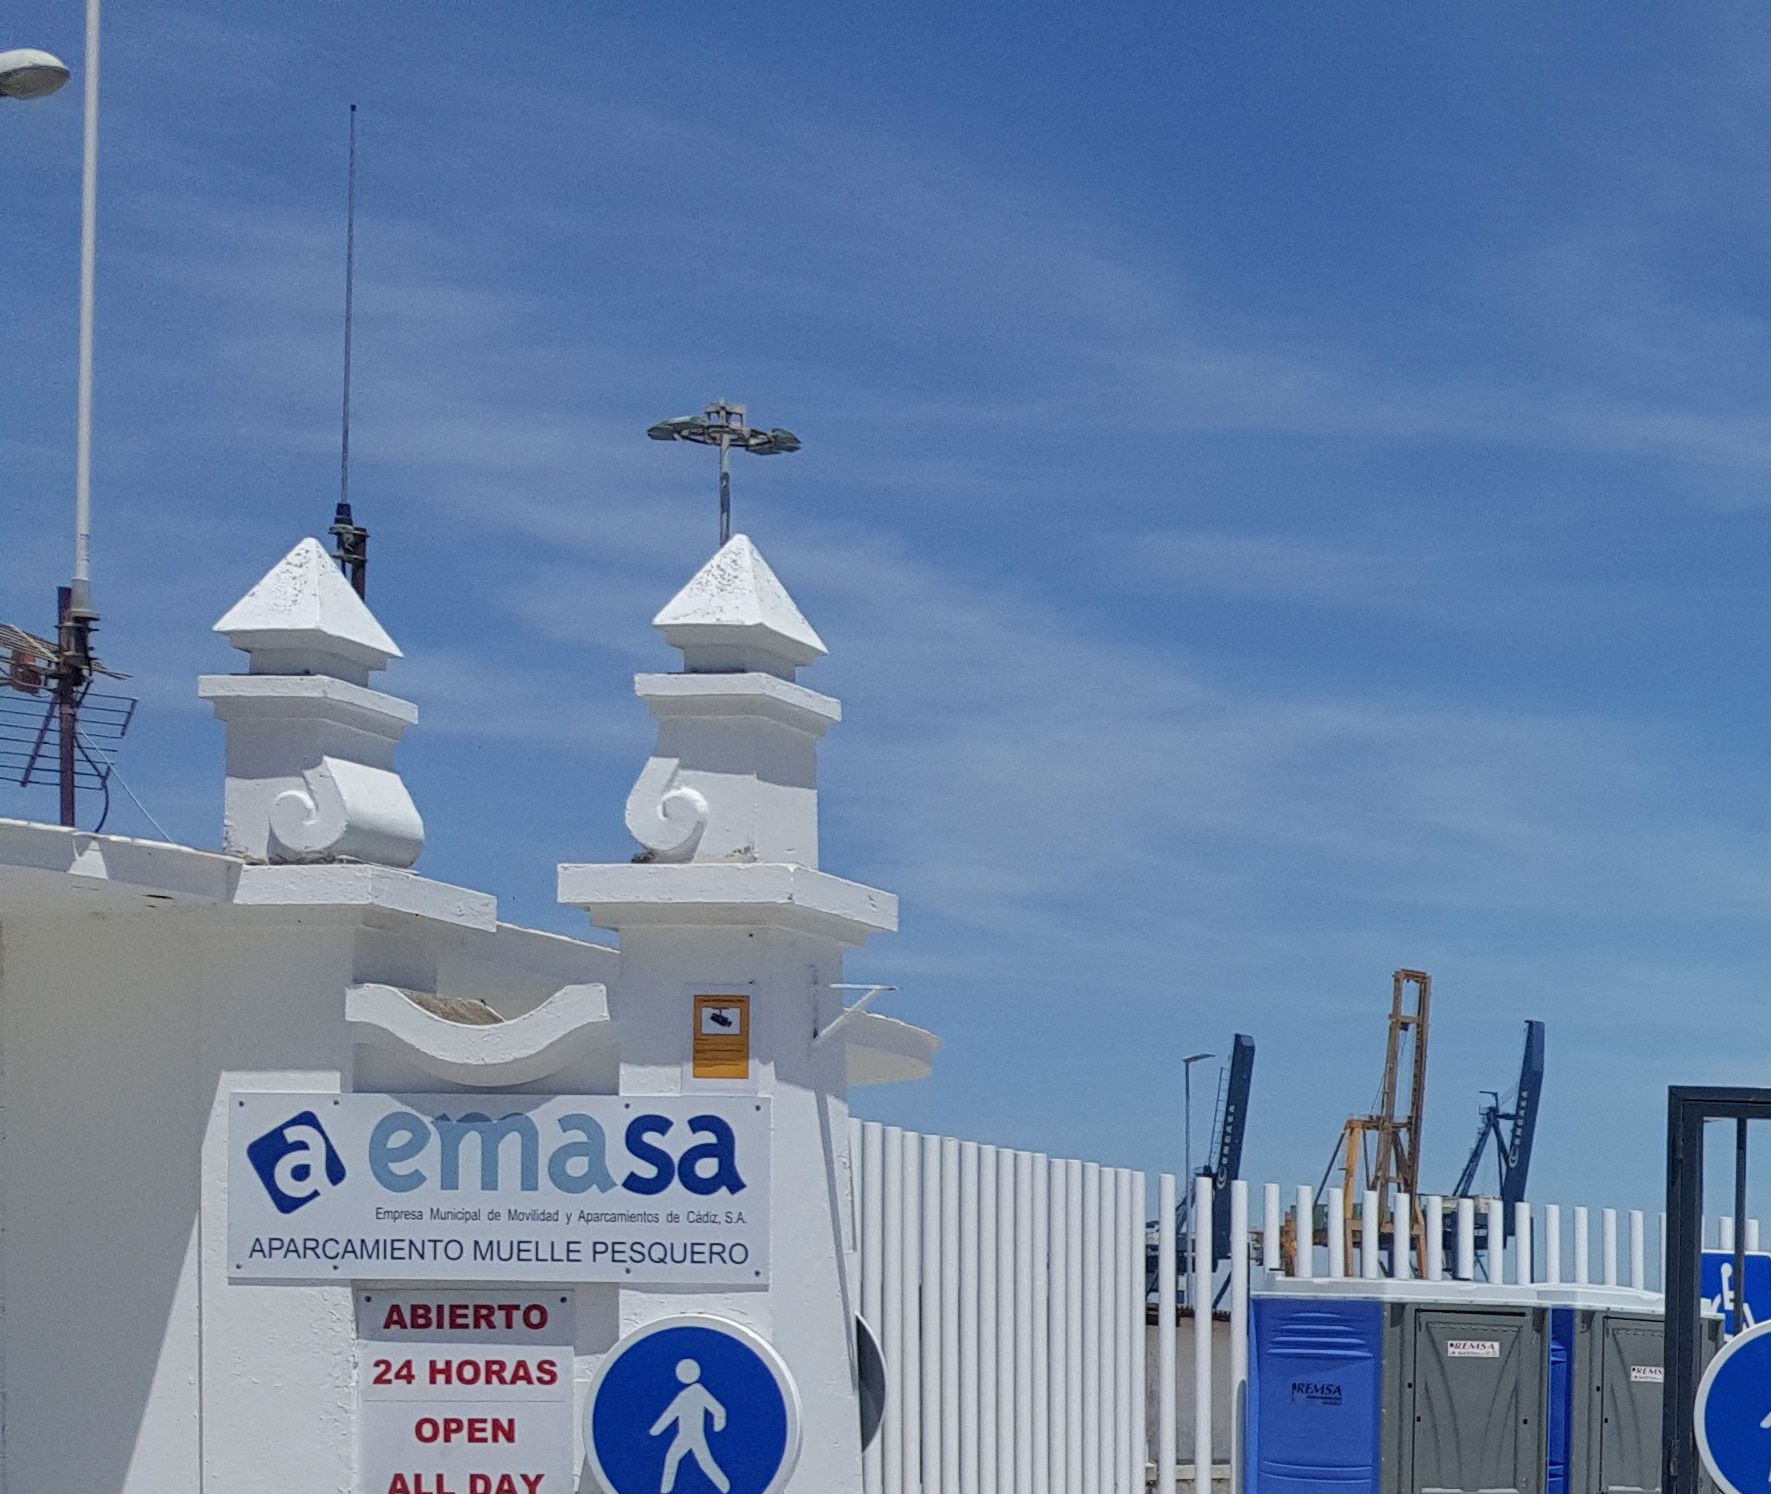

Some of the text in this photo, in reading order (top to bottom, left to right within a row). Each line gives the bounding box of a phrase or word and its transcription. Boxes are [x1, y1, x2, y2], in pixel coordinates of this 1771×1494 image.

[368, 1111, 749, 1196] emasa
[375, 1207, 748, 1225] Empresa Municipal de Movilidad y Aparcamientos de Cádiz, S.A.
[248, 1237, 749, 1265] APARCAMIENTO MUELLE PESQUERO
[382, 1303, 549, 1331] ABIERTO
[372, 1358, 559, 1387] 24 HORAS
[1636, 1367, 1664, 1376] REMS
[1296, 1382, 1342, 1395] REMSA
[414, 1416, 517, 1445] OPEN
